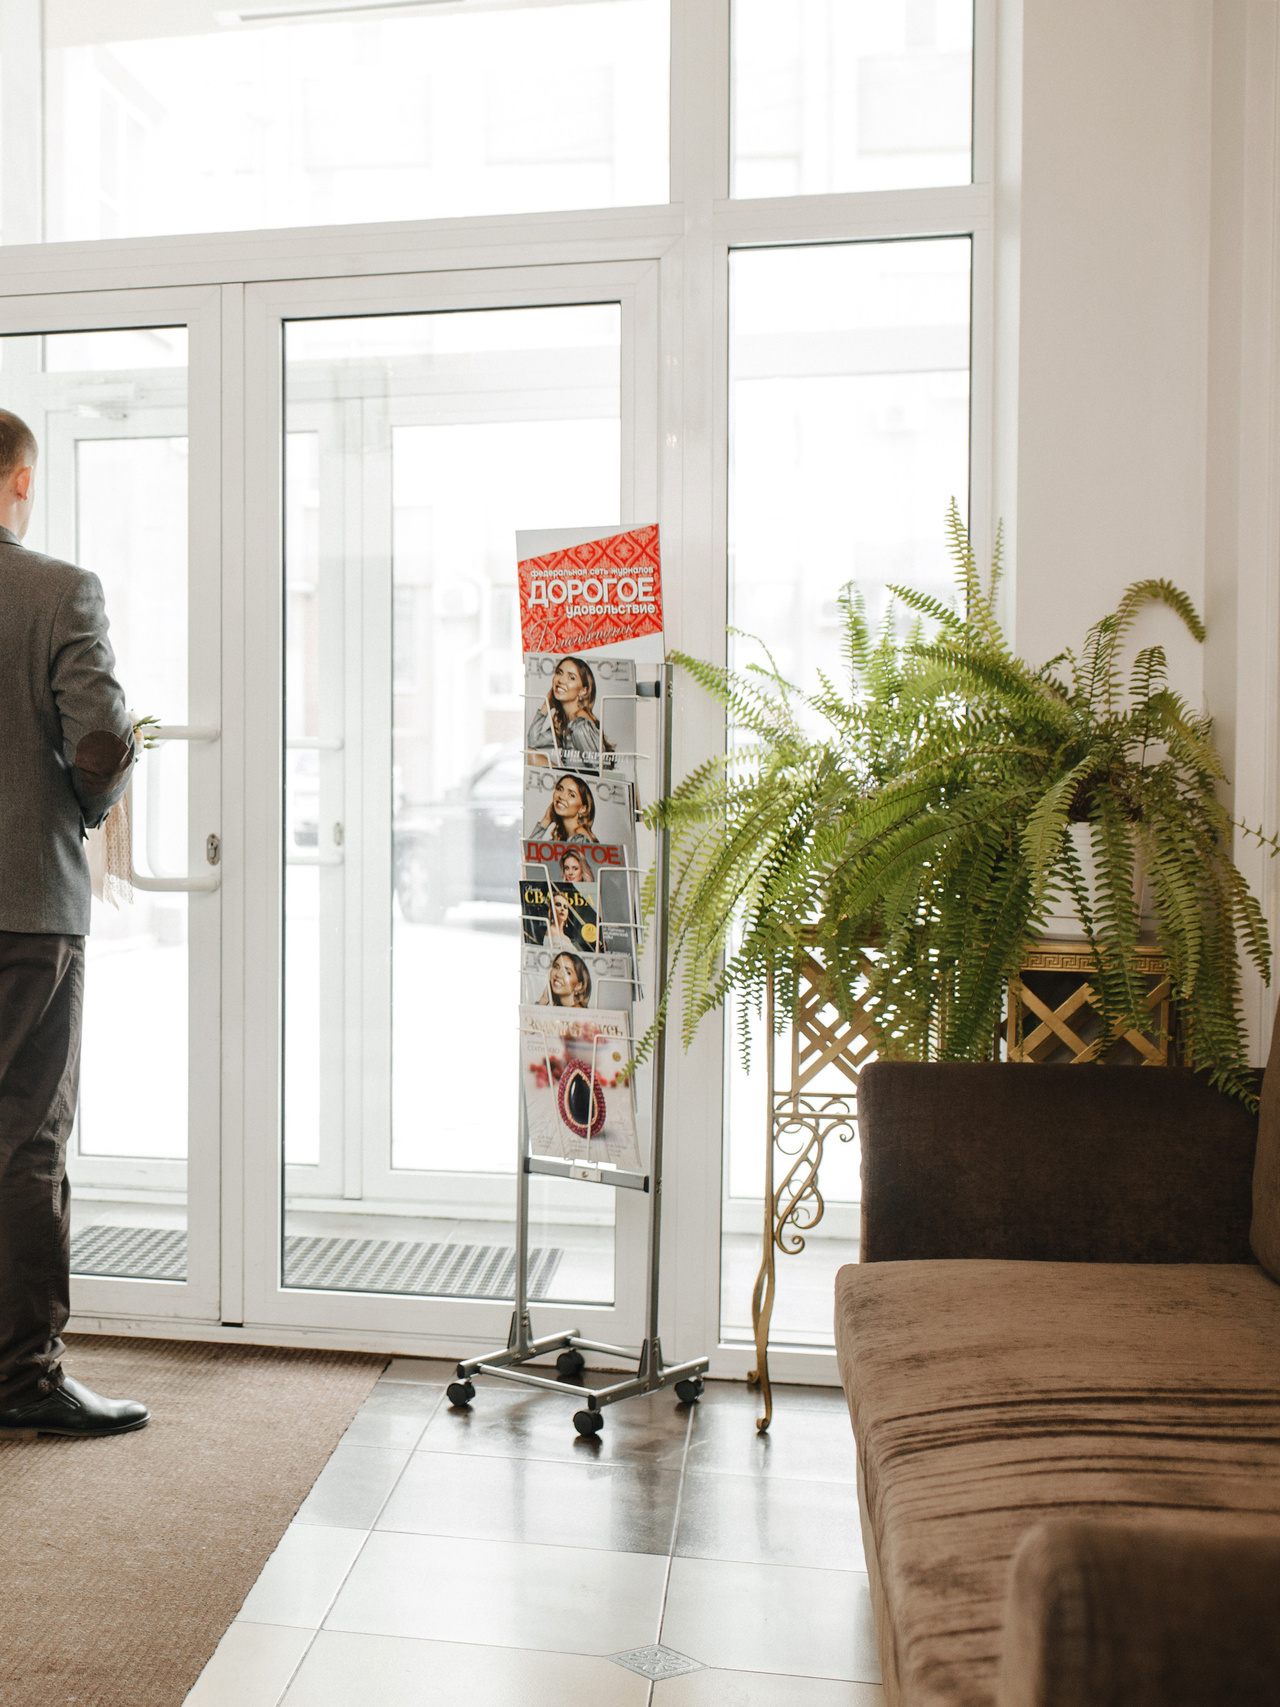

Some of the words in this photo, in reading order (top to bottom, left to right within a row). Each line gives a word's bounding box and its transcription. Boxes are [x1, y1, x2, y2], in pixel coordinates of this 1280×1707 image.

[530, 568, 587, 579] федеральная
[590, 568, 608, 576] сеть
[611, 567, 654, 577] журналов
[528, 577, 656, 609] ДОРОГОЕ
[566, 603, 656, 619] удовольствие
